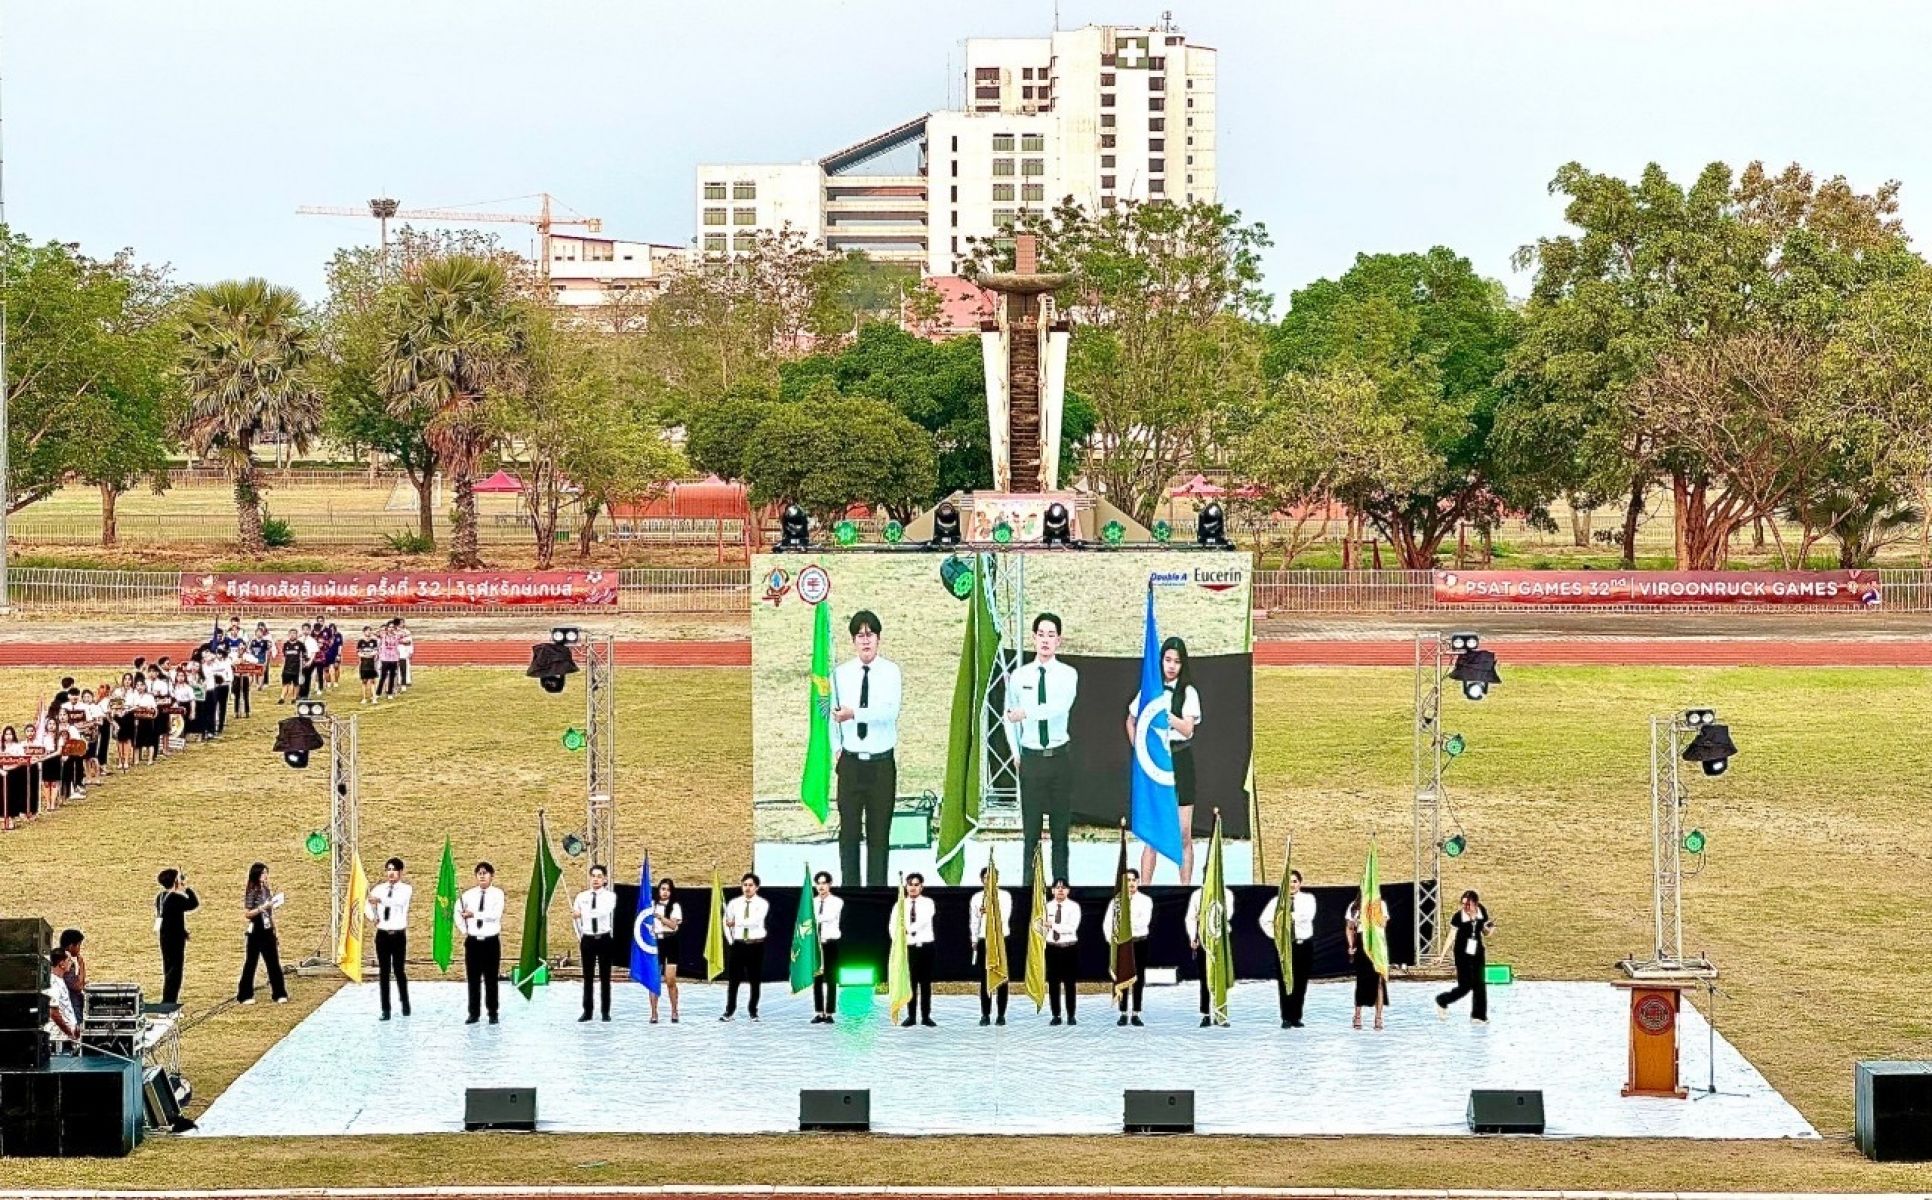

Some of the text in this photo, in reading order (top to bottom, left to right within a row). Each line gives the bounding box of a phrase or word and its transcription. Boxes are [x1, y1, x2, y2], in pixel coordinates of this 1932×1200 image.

[1151, 572, 1187, 581] Double A
[1195, 568, 1242, 582] Eucerin
[417, 581, 441, 597] 32
[1465, 577, 1838, 597] PSAT GAMES 32nd VIROONRUCK GAMES
